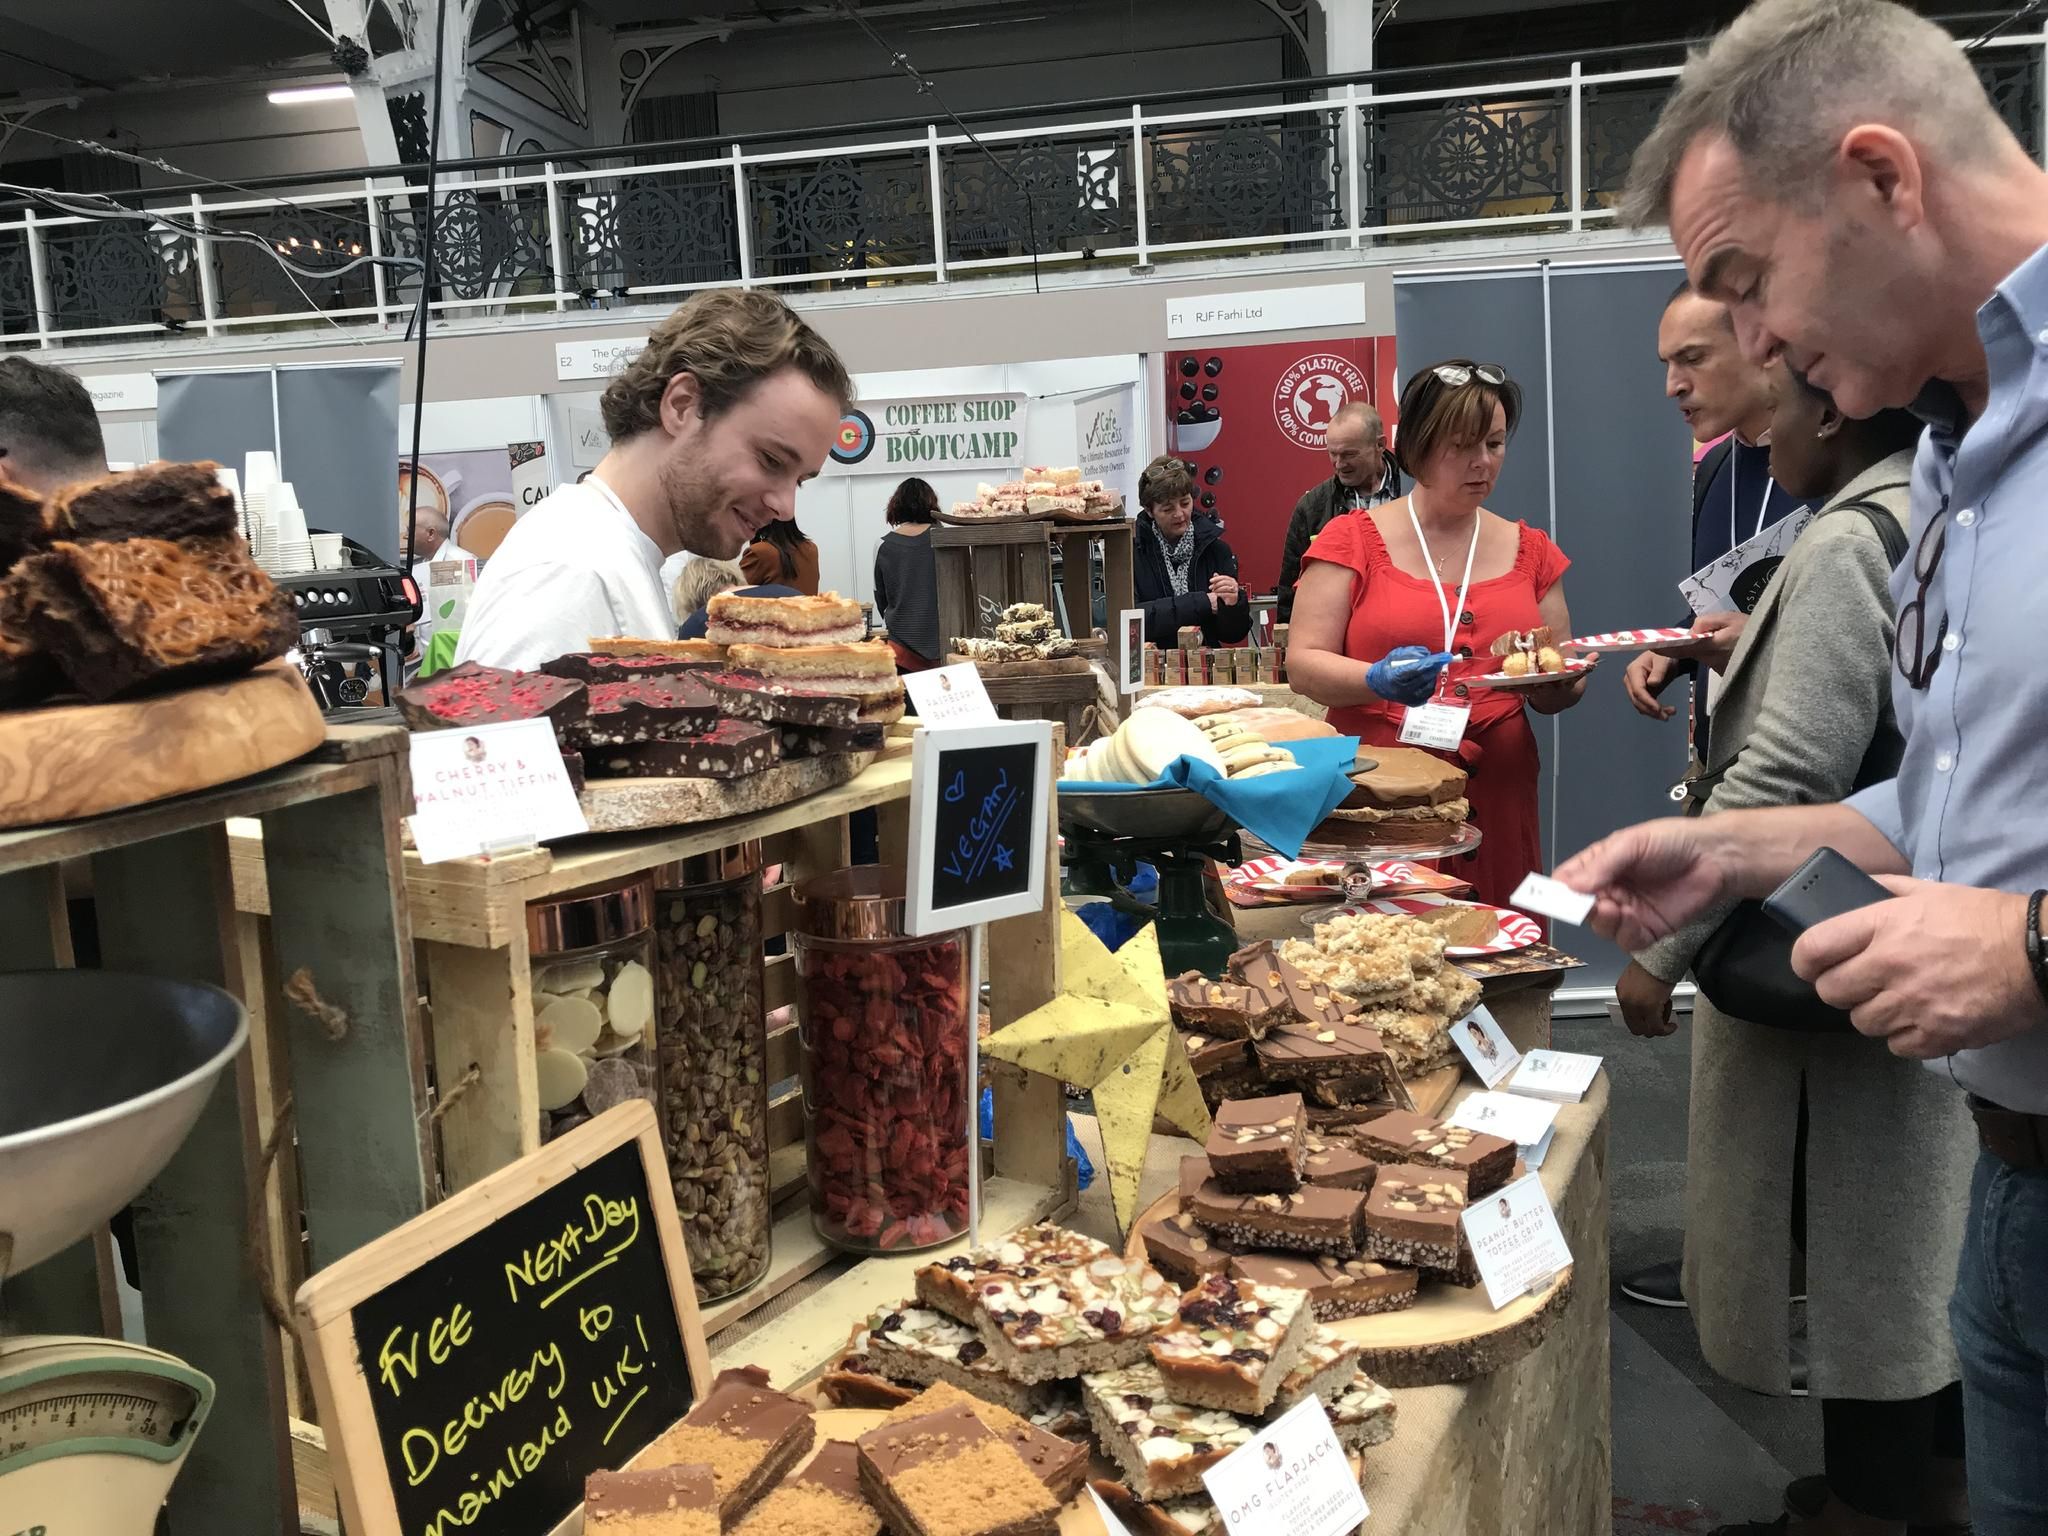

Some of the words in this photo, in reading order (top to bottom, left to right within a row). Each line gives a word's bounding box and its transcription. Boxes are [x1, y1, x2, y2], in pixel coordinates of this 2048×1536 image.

[1171, 313, 1183, 325] F1
[1195, 310, 1215, 323] RJF
[1217, 308, 1243, 321] Farhi
[1245, 307, 1263, 319] Ltd
[560, 356, 573, 368] E2
[592, 348, 610, 358] The
[1278, 370, 1301, 400] 100%
[1299, 357, 1344, 375] PLASTIC
[1342, 367, 1364, 394] FREE
[885, 402, 957, 427] COFFEE
[963, 399, 1018, 423] SHOP
[1278, 407, 1300, 436] 100%
[885, 431, 1018, 463] BOOTCAMP
[413, 782, 487, 805] WALNUT
[498, 772, 558, 791] TIFFIN
[435, 762, 507, 783] CHERRY
[1476, 1224, 1510, 1250] PEANUT
[1512, 1204, 1545, 1229] BUTTER
[1487, 1235, 1520, 1257] TOFFEE
[1520, 1219, 1544, 1239] CRISP
[580, 1303, 614, 1342] to
[1230, 1494, 1262, 1524] OMG
[1265, 1437, 1334, 1496] FLAPJACK
